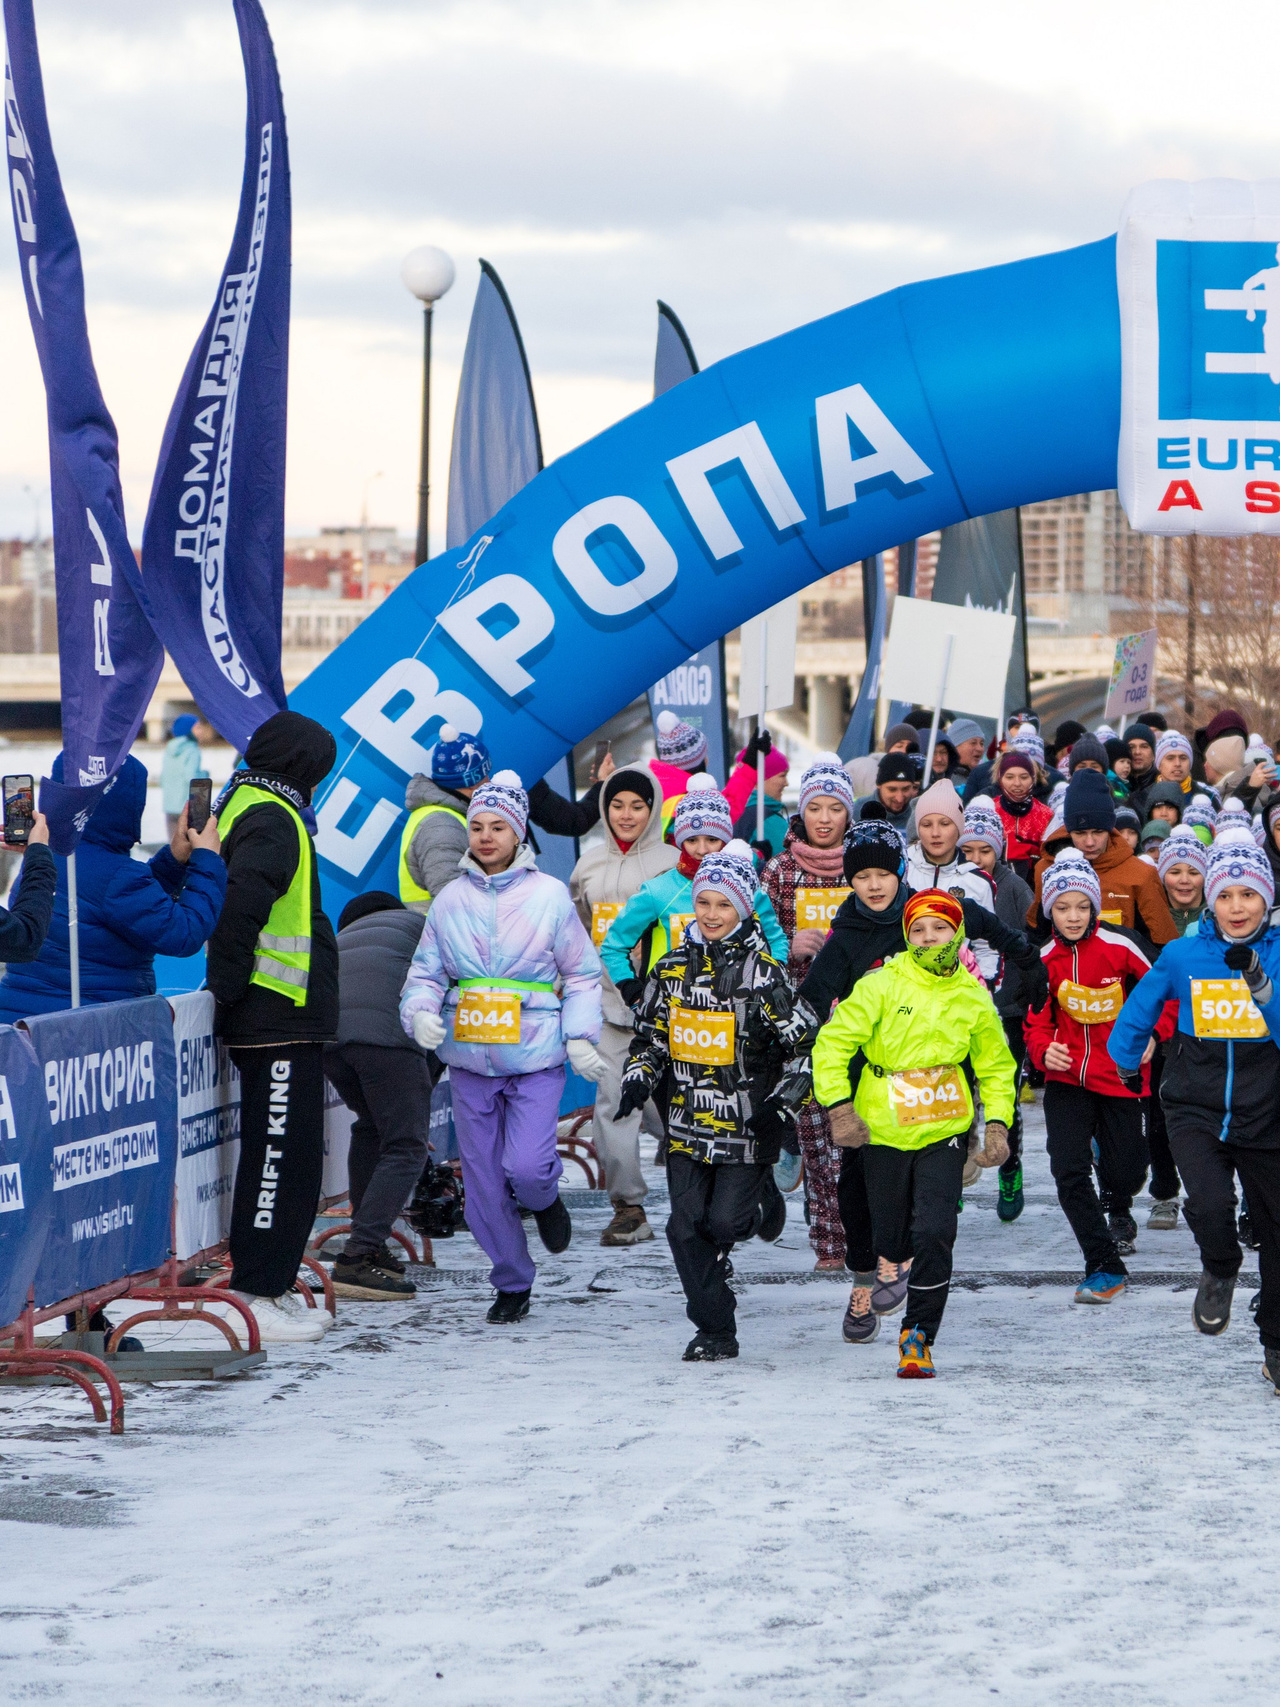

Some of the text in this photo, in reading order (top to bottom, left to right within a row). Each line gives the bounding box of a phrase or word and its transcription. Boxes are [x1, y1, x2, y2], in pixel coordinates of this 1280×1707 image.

[174, 278, 243, 563] ДОМА ДЛЯ
[312, 383, 934, 878] ЕВРОПА
[1131, 662, 1148, 684] 0-3
[1124, 685, 1148, 704] года
[463, 770, 481, 788] FIS
[805, 905, 838, 921] 510
[1067, 996, 1114, 1013] 5142
[1201, 1000, 1262, 1020] 5079
[458, 1008, 514, 1028] 5044
[673, 1025, 728, 1049] 5004
[44, 1041, 155, 1126] ВИКТОРИЯ
[904, 1083, 960, 1108] 5042
[254, 1060, 292, 1230] DRIFT KING
